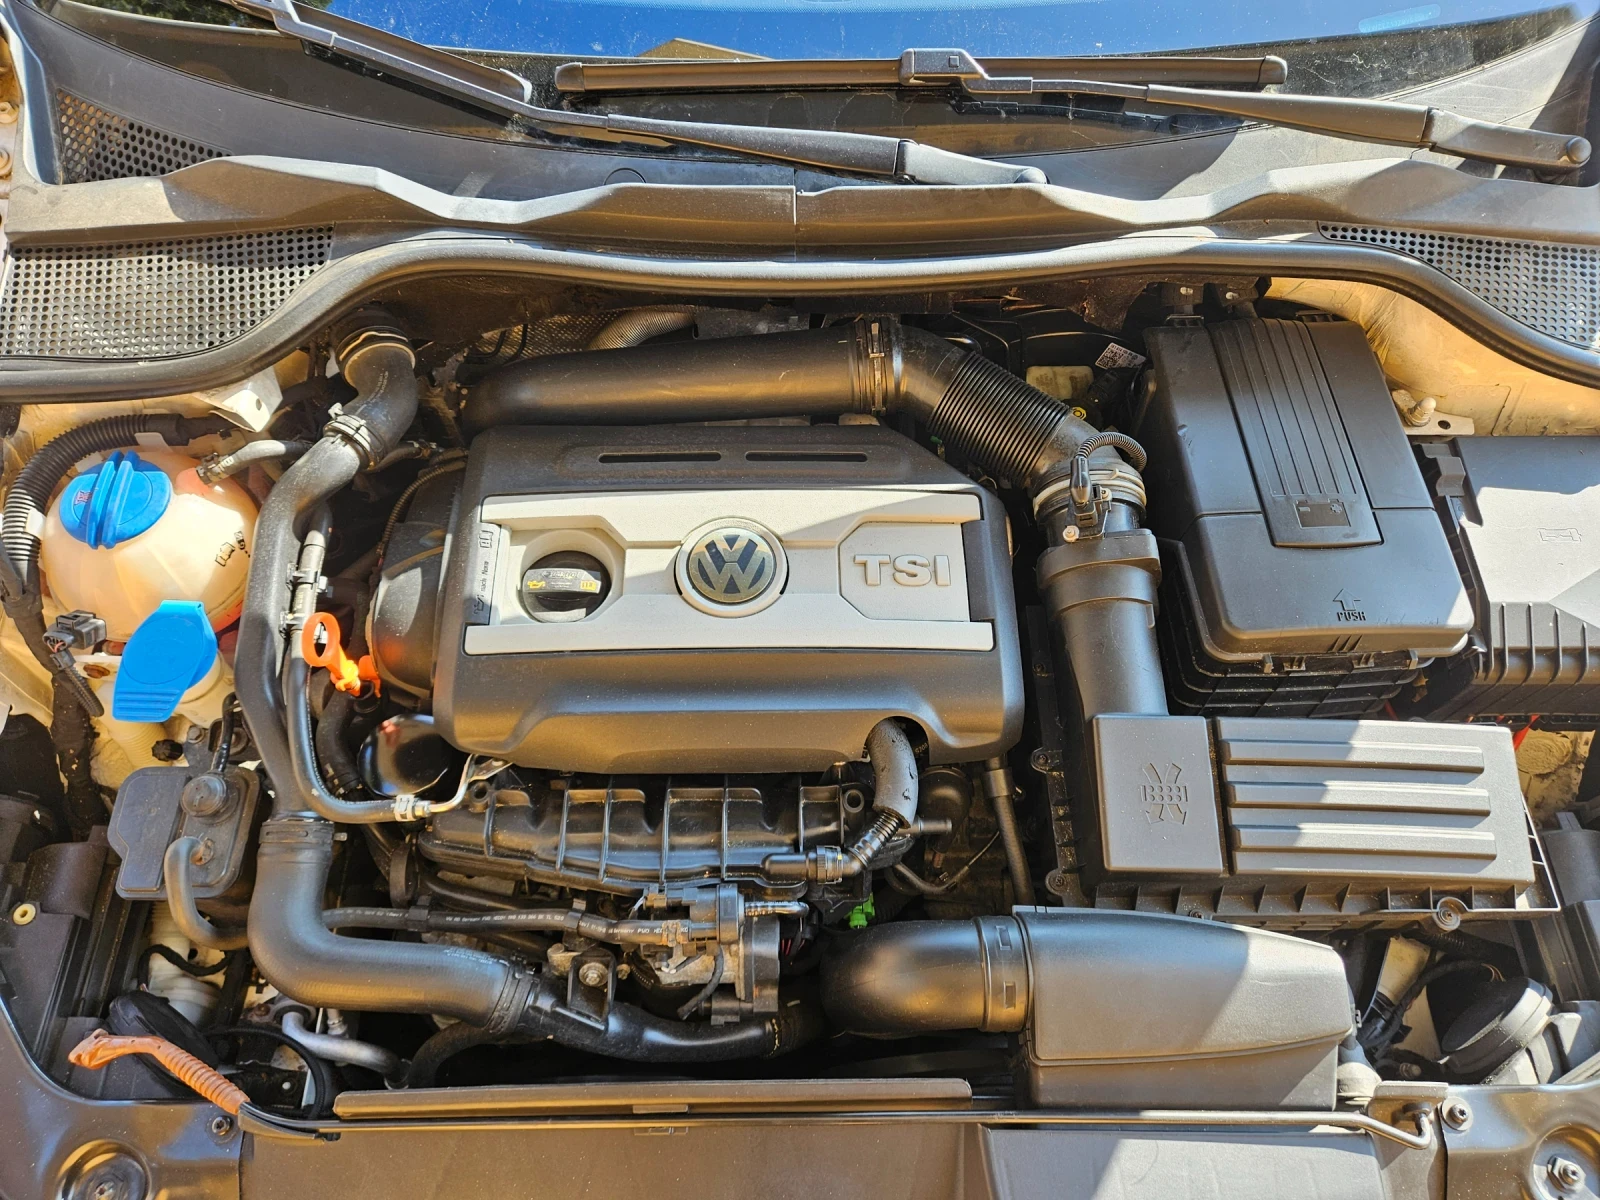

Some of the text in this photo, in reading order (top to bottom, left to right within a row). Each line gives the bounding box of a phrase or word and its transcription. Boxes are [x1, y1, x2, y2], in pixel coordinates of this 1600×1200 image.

[690, 528, 774, 602] VW
[854, 554, 951, 586] TSI
[1337, 611, 1366, 621] PUSH
